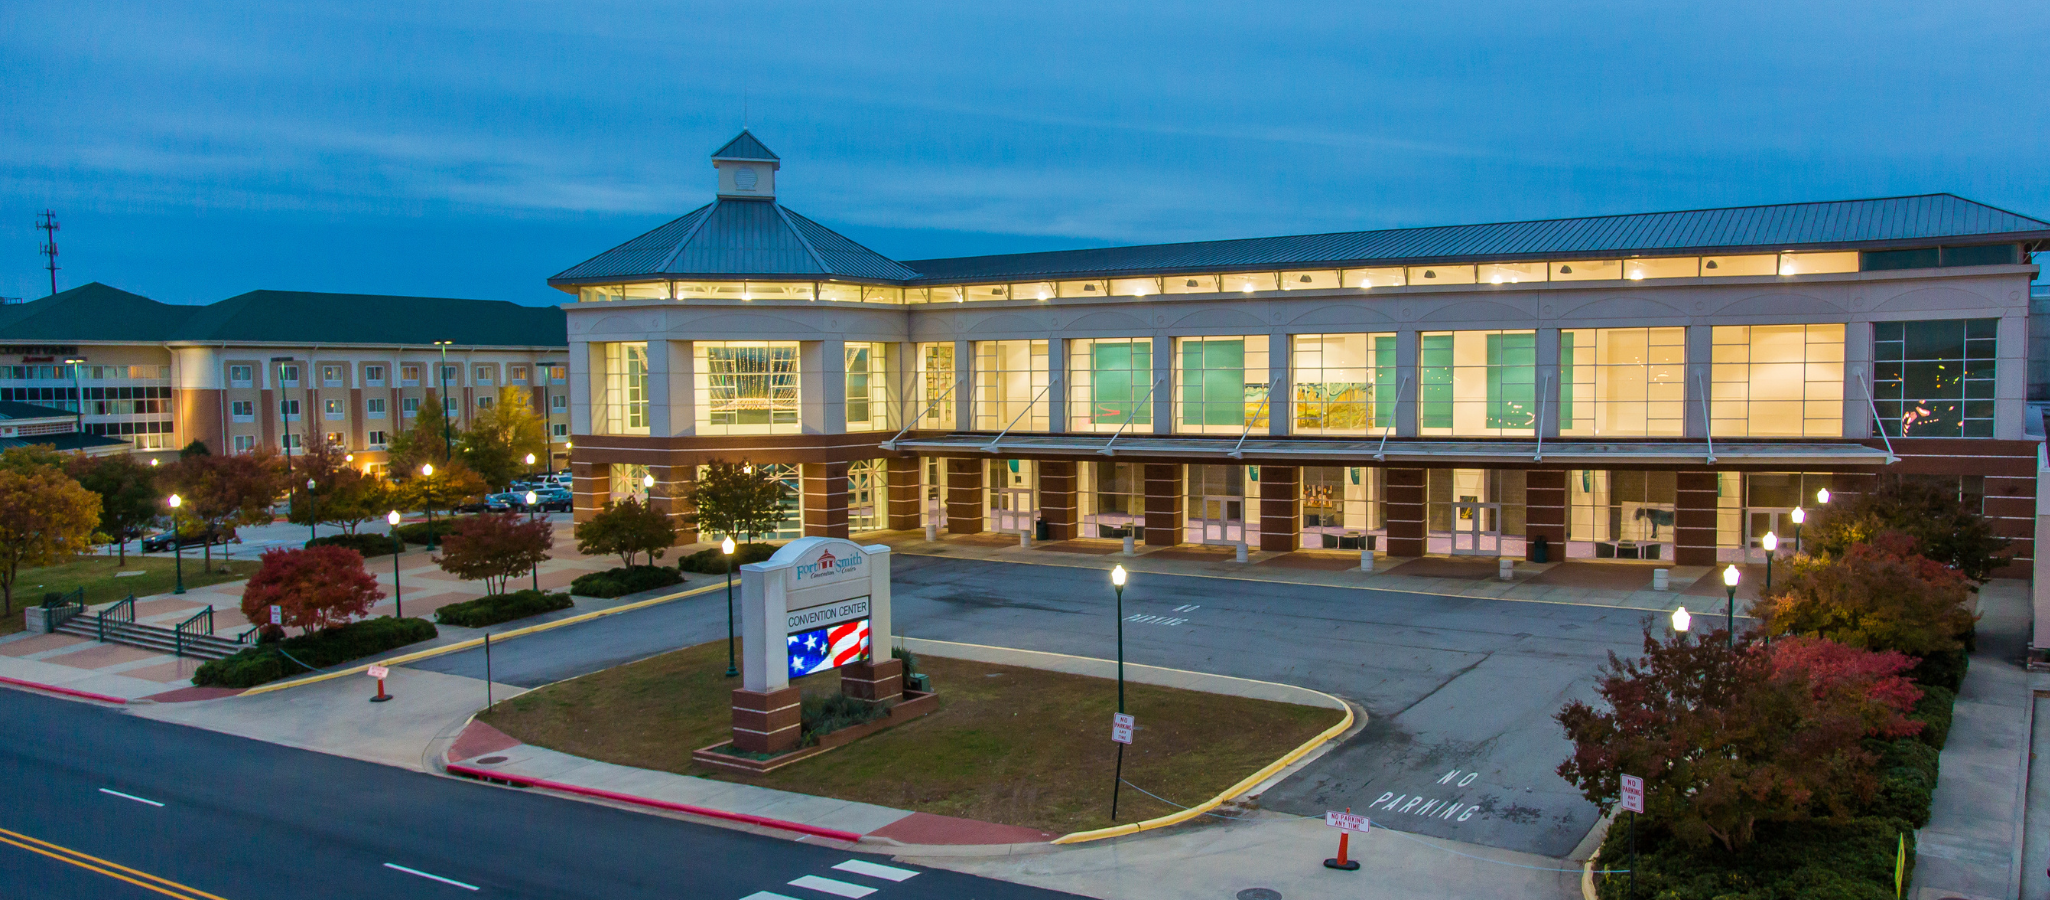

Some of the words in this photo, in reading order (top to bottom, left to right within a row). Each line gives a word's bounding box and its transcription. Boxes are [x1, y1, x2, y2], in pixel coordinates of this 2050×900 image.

[796, 562, 818, 580] Fort
[835, 552, 862, 573] Smith
[788, 608, 837, 627] CONVENTION
[839, 602, 867, 617] CENTER
[1120, 716, 1128, 724] NO
[1115, 722, 1132, 731] PARKING
[1437, 769, 1478, 787] NO
[1627, 779, 1636, 787] NO
[1622, 786, 1641, 797] PARKING
[1369, 791, 1480, 822] PARKING
[1341, 815, 1365, 824] PARKING
[1348, 822, 1361, 830] TIME
